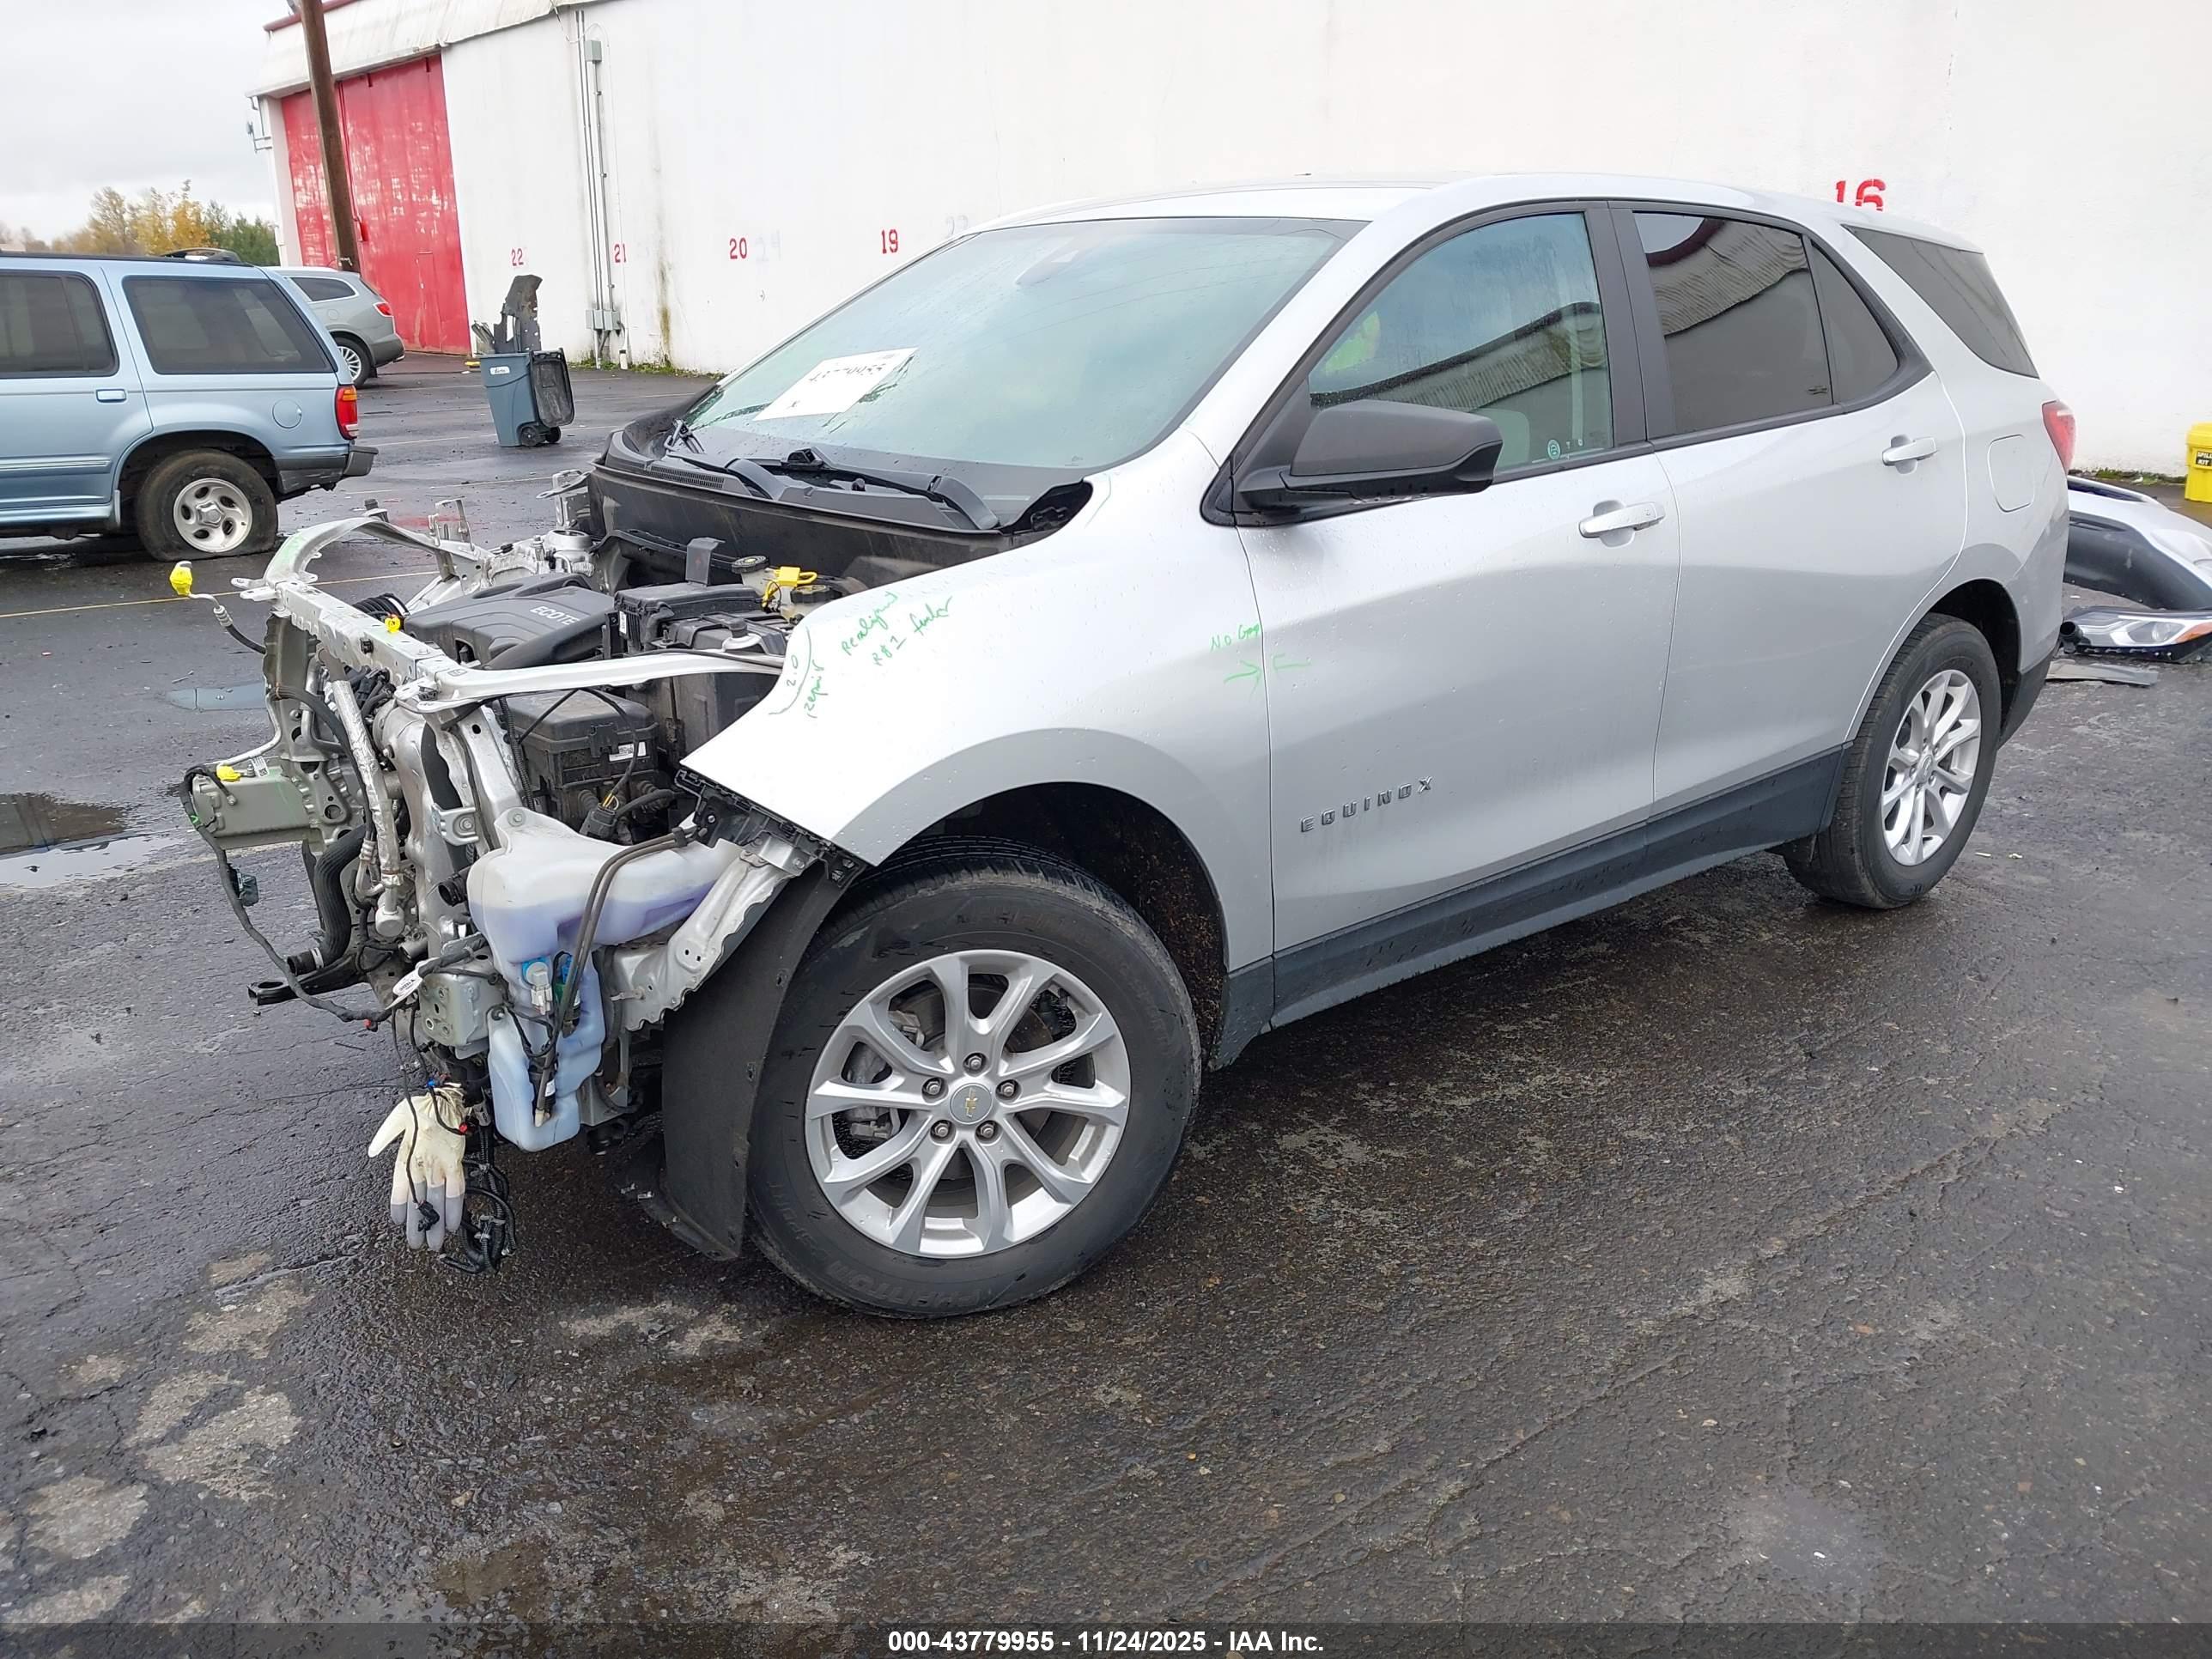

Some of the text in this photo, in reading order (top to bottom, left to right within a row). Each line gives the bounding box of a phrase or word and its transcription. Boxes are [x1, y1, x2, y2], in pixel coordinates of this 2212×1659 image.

[1835, 179, 1887, 212] 16
[728, 236, 748, 260] 20
[880, 228, 900, 254] 19
[510, 247, 525, 267] 22
[613, 243, 628, 264] 21
[529, 605, 580, 626] ECOTE
[1300, 775, 1433, 833] EQUINOX
